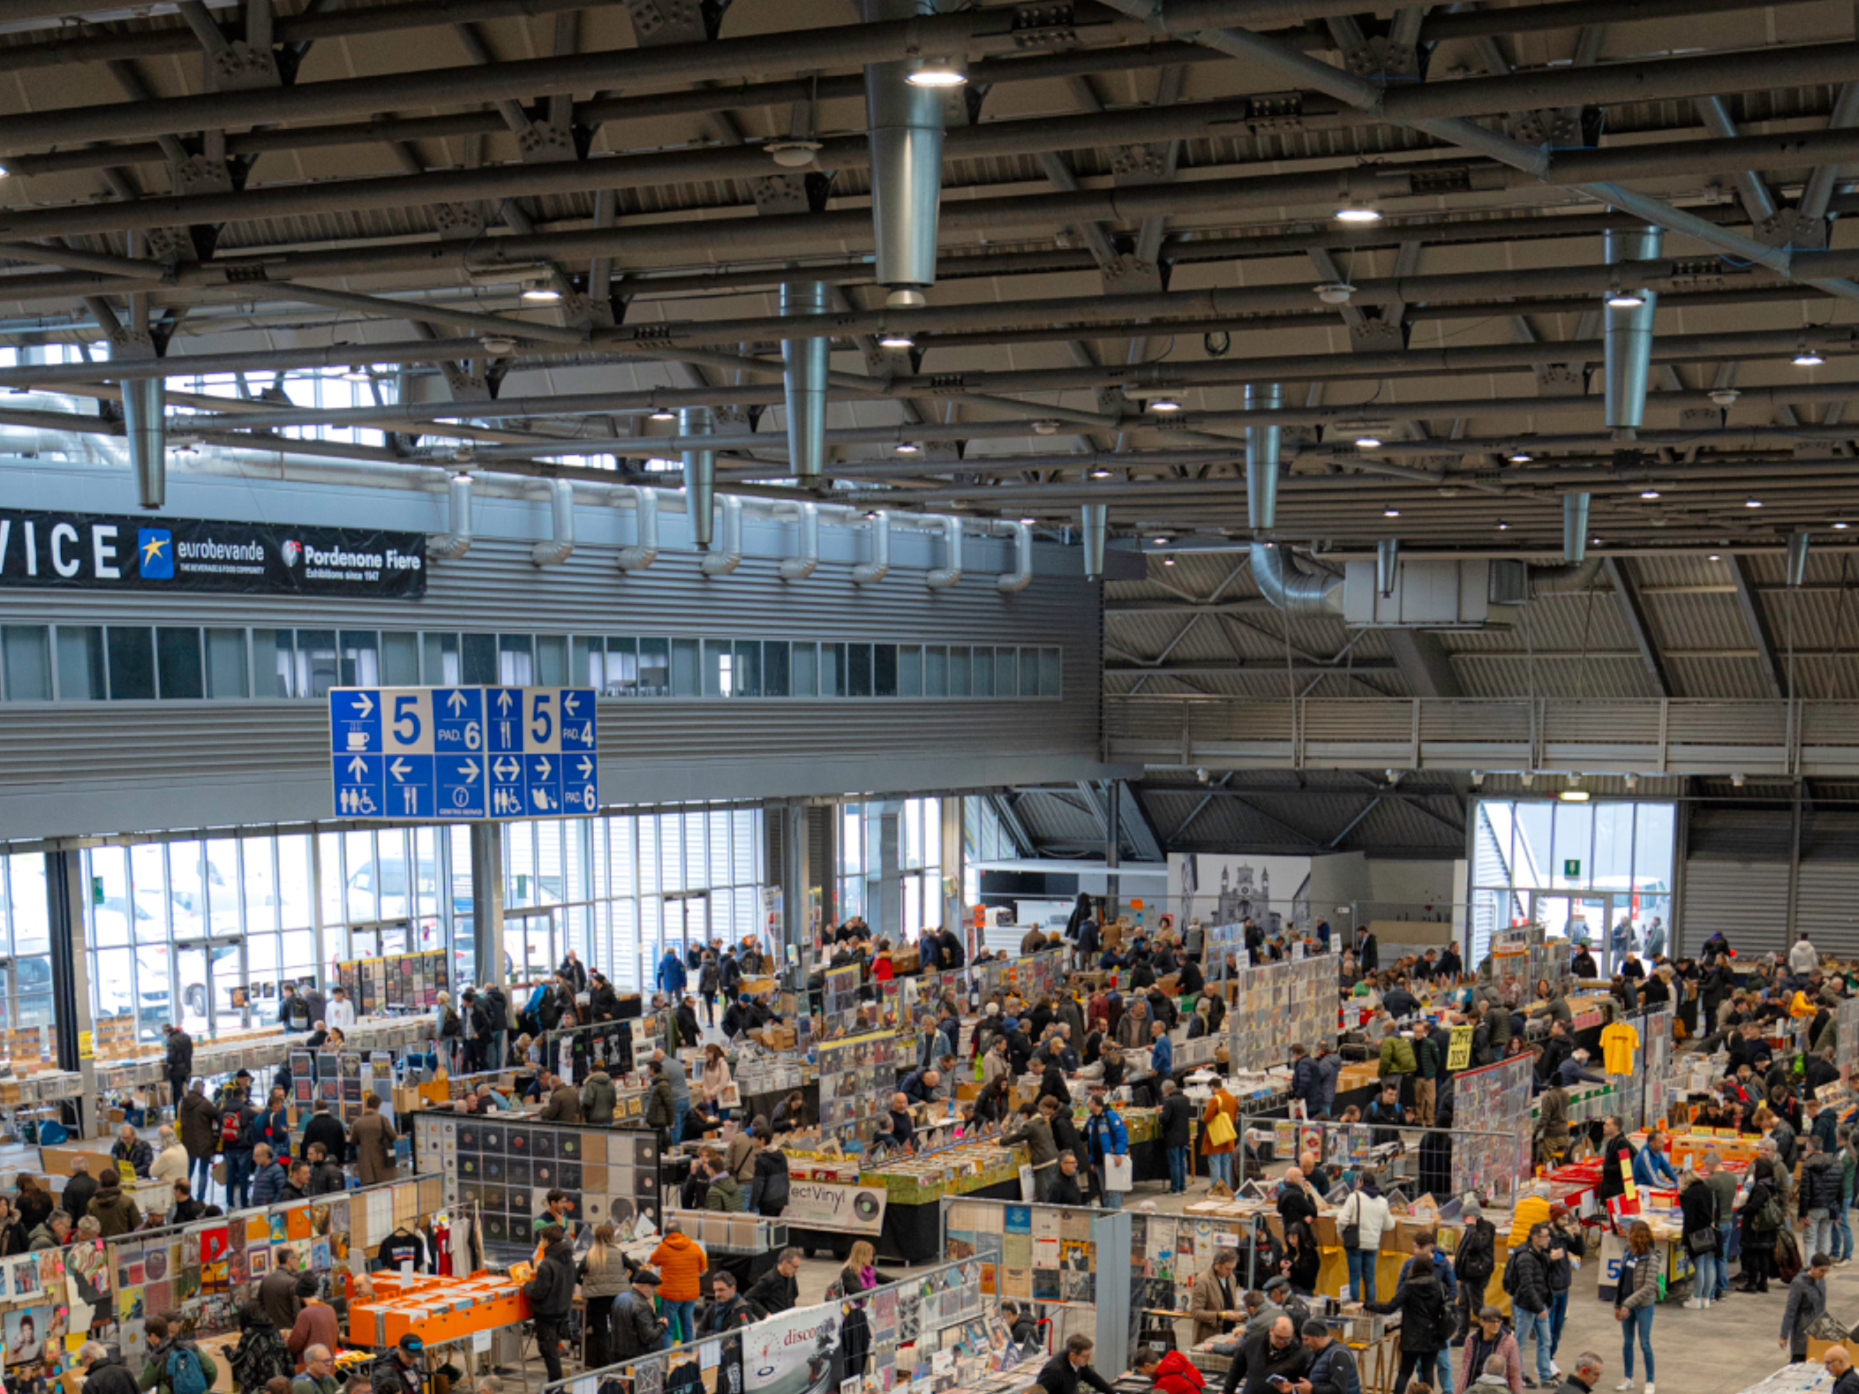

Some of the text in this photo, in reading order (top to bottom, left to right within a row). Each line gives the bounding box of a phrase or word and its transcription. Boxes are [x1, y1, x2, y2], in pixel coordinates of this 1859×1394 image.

[178, 538, 264, 561] eurobevande
[304, 545, 421, 569] Pordenone Fiere
[306, 568, 343, 580] Exhibitions
[344, 570, 363, 581] since
[392, 695, 421, 745] 5
[531, 694, 552, 744] 5
[437, 721, 481, 750] PAD. 6
[562, 721, 594, 748] PAD. 4
[565, 784, 595, 812] PAD. 6
[791, 1185, 846, 1214] ectVinyl
